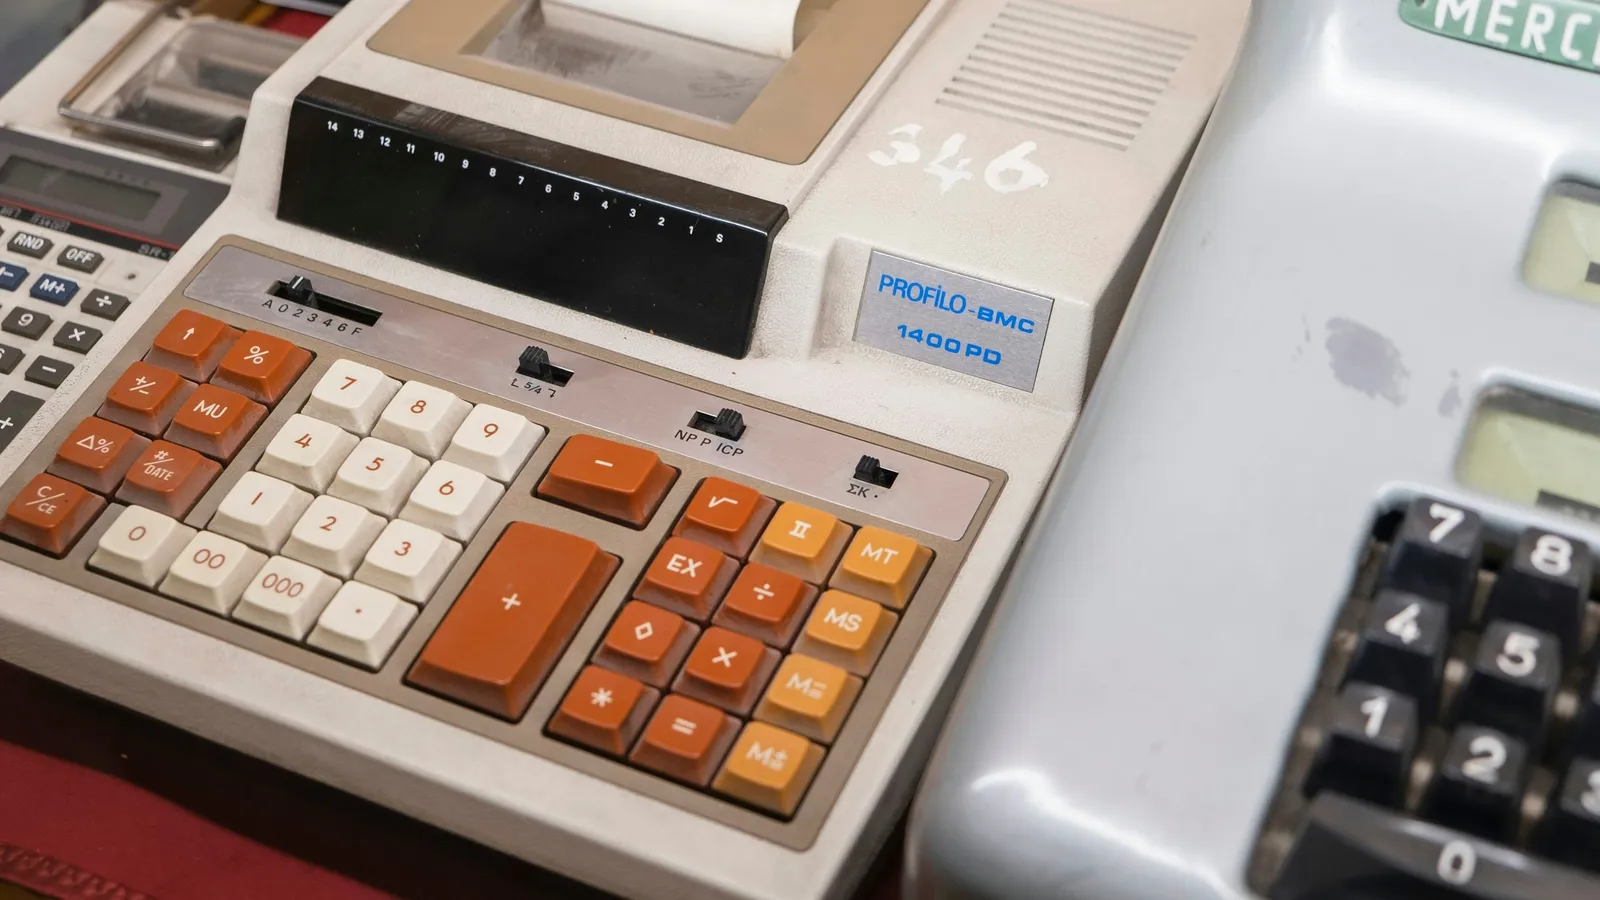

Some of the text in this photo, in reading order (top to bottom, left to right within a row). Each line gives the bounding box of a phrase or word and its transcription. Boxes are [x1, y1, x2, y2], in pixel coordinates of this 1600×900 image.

[1434, 0, 1600, 66] MERC
[868, 123, 1049, 194] 346
[327, 120, 724, 243] 14 13 12 11 10 9 8 7 6 5 4 3 2 1 S
[13, 233, 45, 250] RND
[66, 248, 95, 263] OFF
[39, 278, 66, 294] M+
[18, 313, 34, 327] 9
[897, 324, 1002, 366] 1400 PD
[339, 376, 358, 391] 7
[193, 399, 228, 419] MU
[410, 399, 427, 414] 8
[294, 433, 313, 448] 4
[483, 423, 499, 438] 9
[674, 429, 744, 457] NP P ICP
[143, 464, 175, 481] DATE
[365, 456, 385, 472] 5
[251, 491, 263, 506] 1
[438, 480, 455, 496] 6
[128, 526, 146, 541] 0
[319, 515, 338, 532] 2
[1429, 502, 1465, 544] 7
[193, 548, 226, 569] 00
[393, 541, 412, 557] 3
[860, 542, 899, 565] MT
[1529, 534, 1573, 577] 8
[666, 553, 703, 578] EX
[261, 572, 304, 598] 000
[823, 607, 863, 632] MS
[1384, 602, 1421, 644] 4
[1496, 632, 1540, 677] 5
[1360, 695, 1388, 738] 1
[1462, 735, 1507, 785] 2
[1436, 840, 1477, 886] 0
